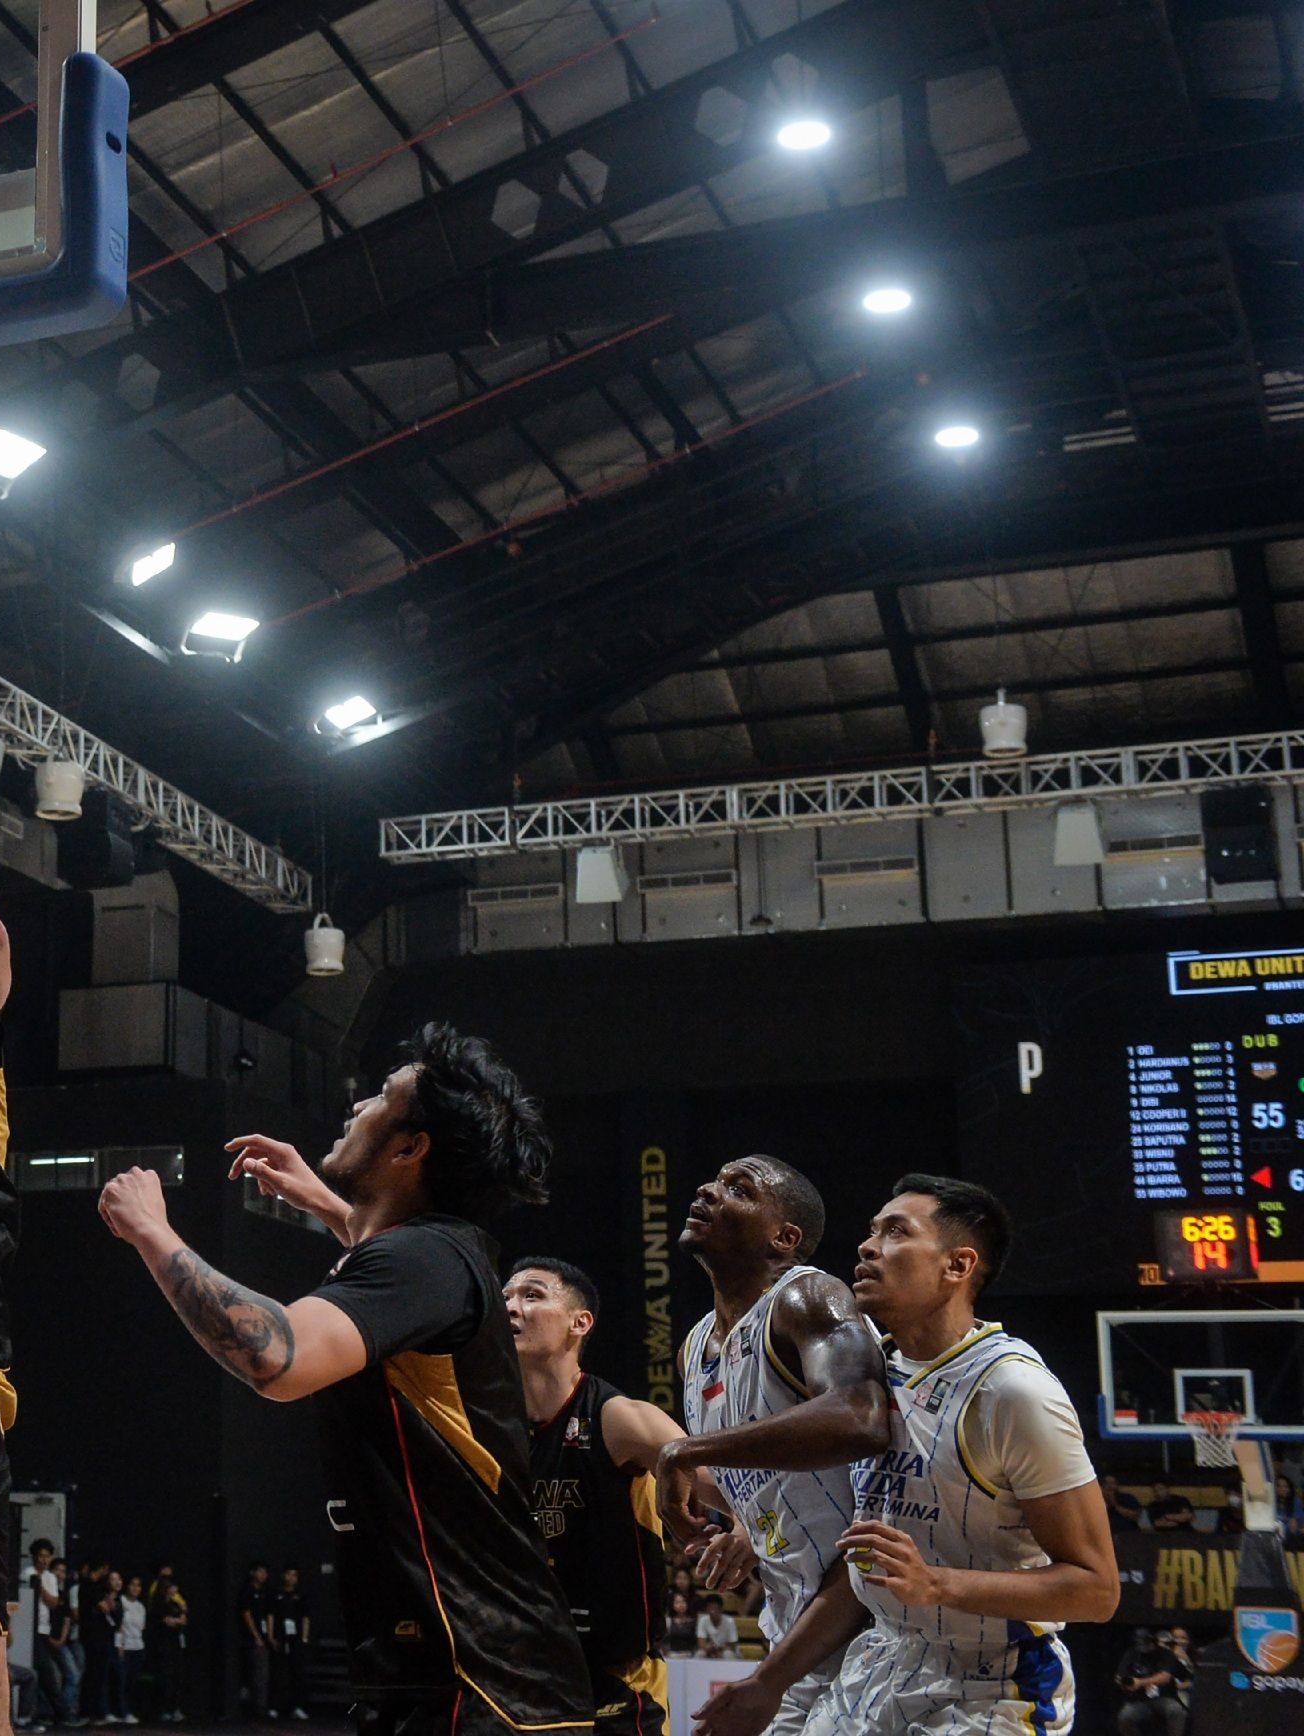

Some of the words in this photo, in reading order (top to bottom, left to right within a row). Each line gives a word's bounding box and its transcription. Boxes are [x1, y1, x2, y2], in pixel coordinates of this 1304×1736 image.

[1189, 958, 1252, 980] DEWA
[1251, 1102, 1287, 1130] 55
[641, 1147, 672, 1289] UNITED
[1181, 1214, 1237, 1242] 6:26
[1265, 1215, 1283, 1239] 3
[1192, 1241, 1228, 1270] 14
